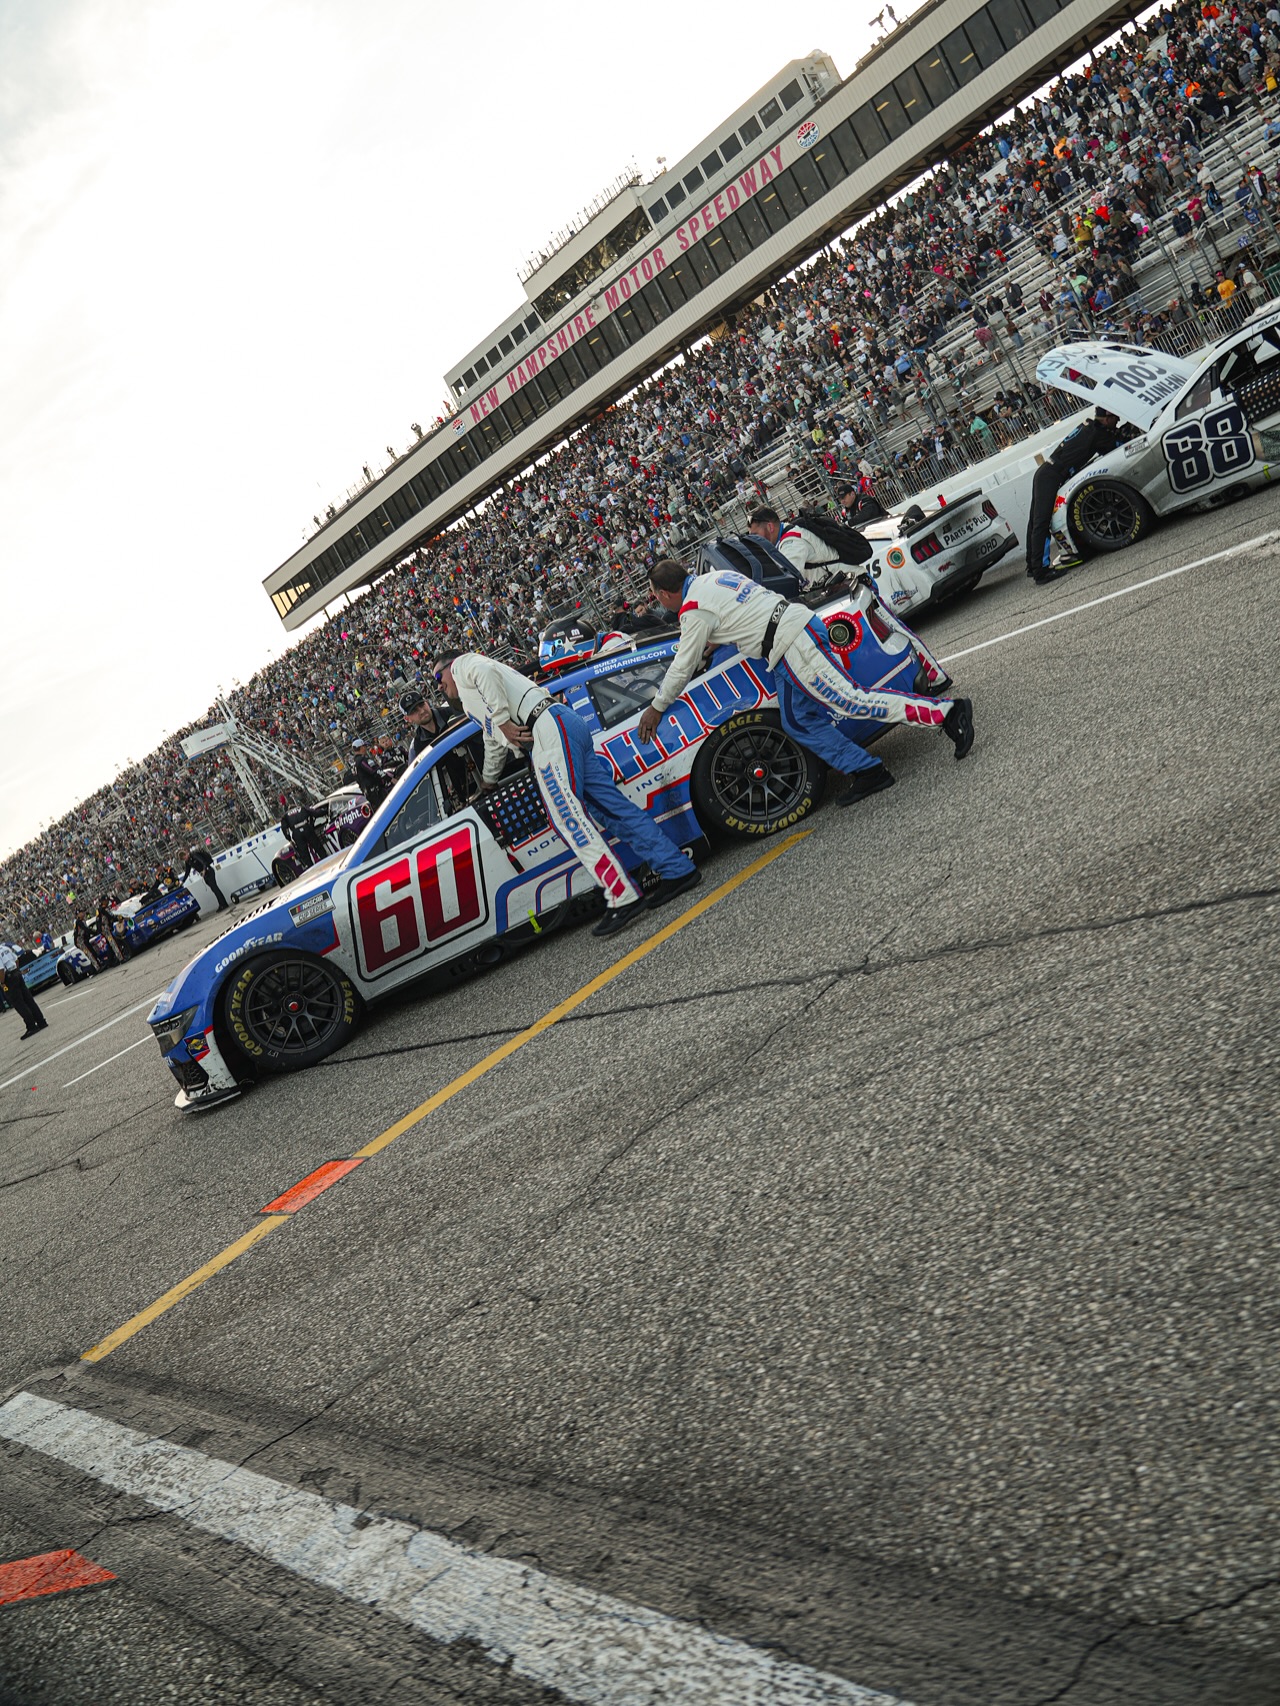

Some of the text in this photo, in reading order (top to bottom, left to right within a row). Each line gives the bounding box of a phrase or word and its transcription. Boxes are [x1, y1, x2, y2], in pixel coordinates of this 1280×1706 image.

[469, 144, 785, 424] NEW HAMPSHIRE MOTOR SPEEDWAY
[1103, 360, 1168, 394] COOL
[1137, 374, 1188, 407] INFINITE
[1162, 402, 1256, 494] 88
[1073, 485, 1094, 532] GOODYEAR
[943, 512, 988, 546] PARTS PLUS
[975, 538, 998, 559] FORD
[593, 658, 618, 670] BUILD
[594, 650, 667, 675] SUBMARINES.COM
[720, 713, 763, 737] EAGLE
[343, 809, 361, 825] right.
[725, 797, 812, 834] GOODYEAR
[159, 906, 188, 925] CHEVROLET
[298, 902, 328, 922] CUP SERIES
[301, 895, 324, 910] NASCAR
[355, 826, 481, 974] 60
[214, 931, 284, 974] GOODYEAR
[229, 969, 263, 1057] GOODYEAR
[340, 980, 354, 1025] EAGLE
